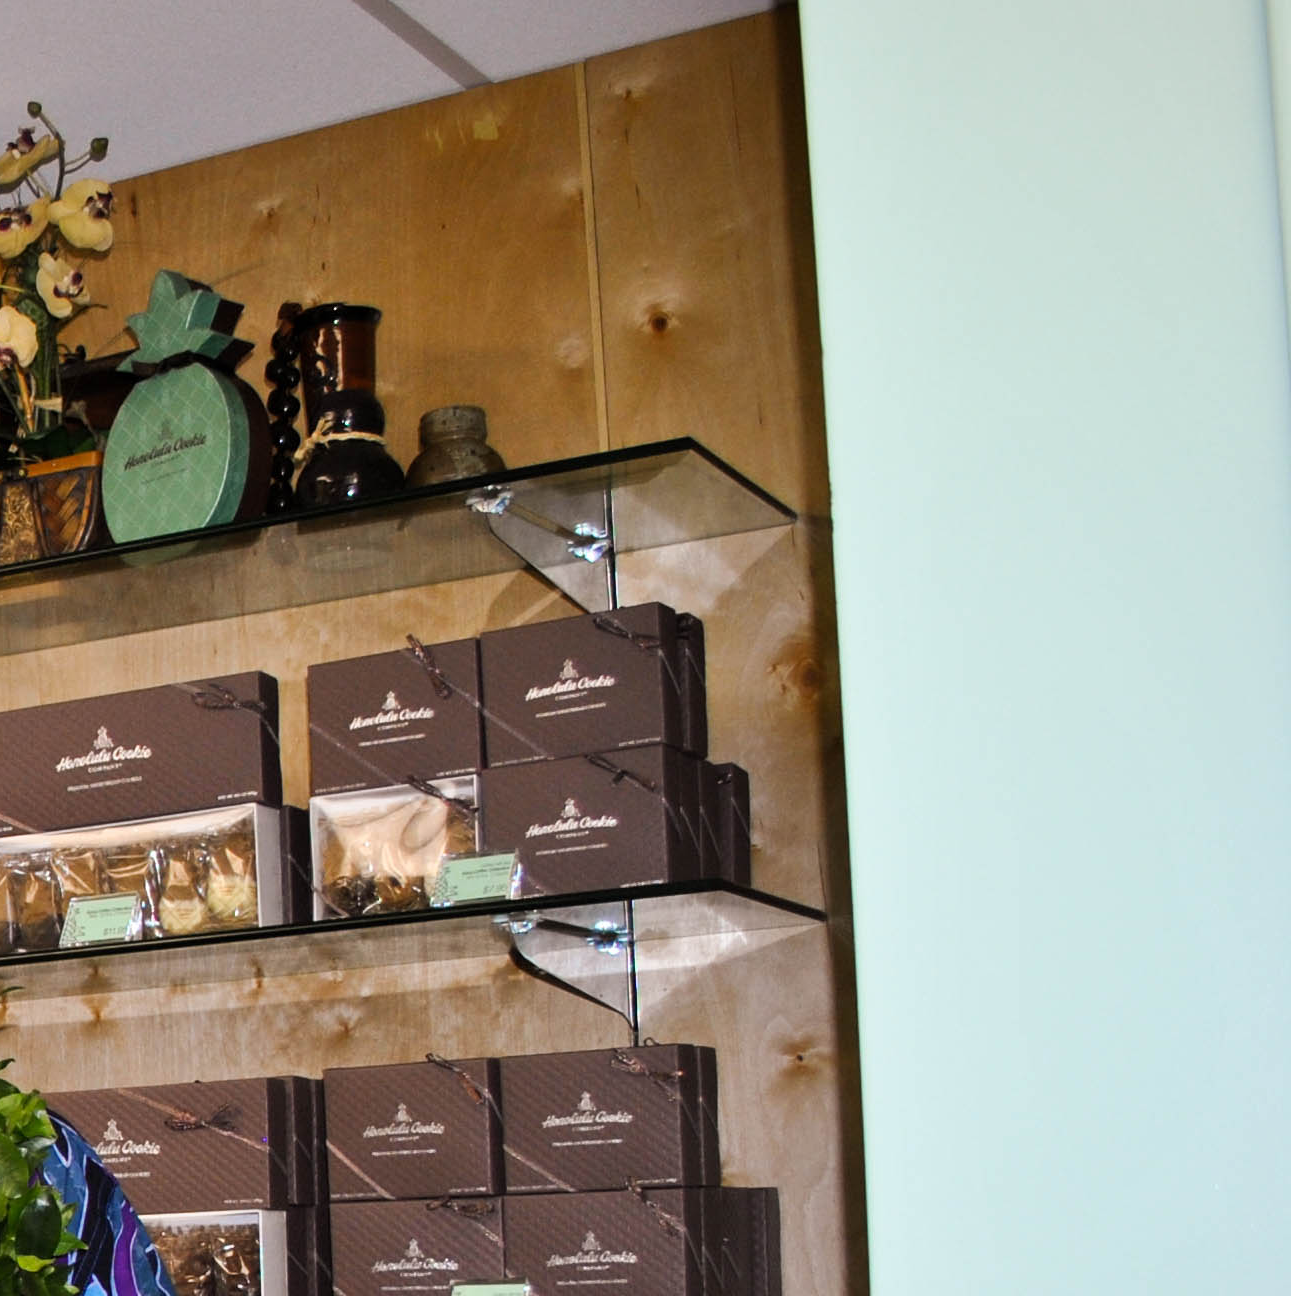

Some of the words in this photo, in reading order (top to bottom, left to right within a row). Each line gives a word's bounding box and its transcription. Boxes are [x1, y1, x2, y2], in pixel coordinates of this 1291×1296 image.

[56, 749, 112, 772] Honolulu
[112, 745, 153, 761] Cookie
[122, 1139, 162, 1156] Cookie
